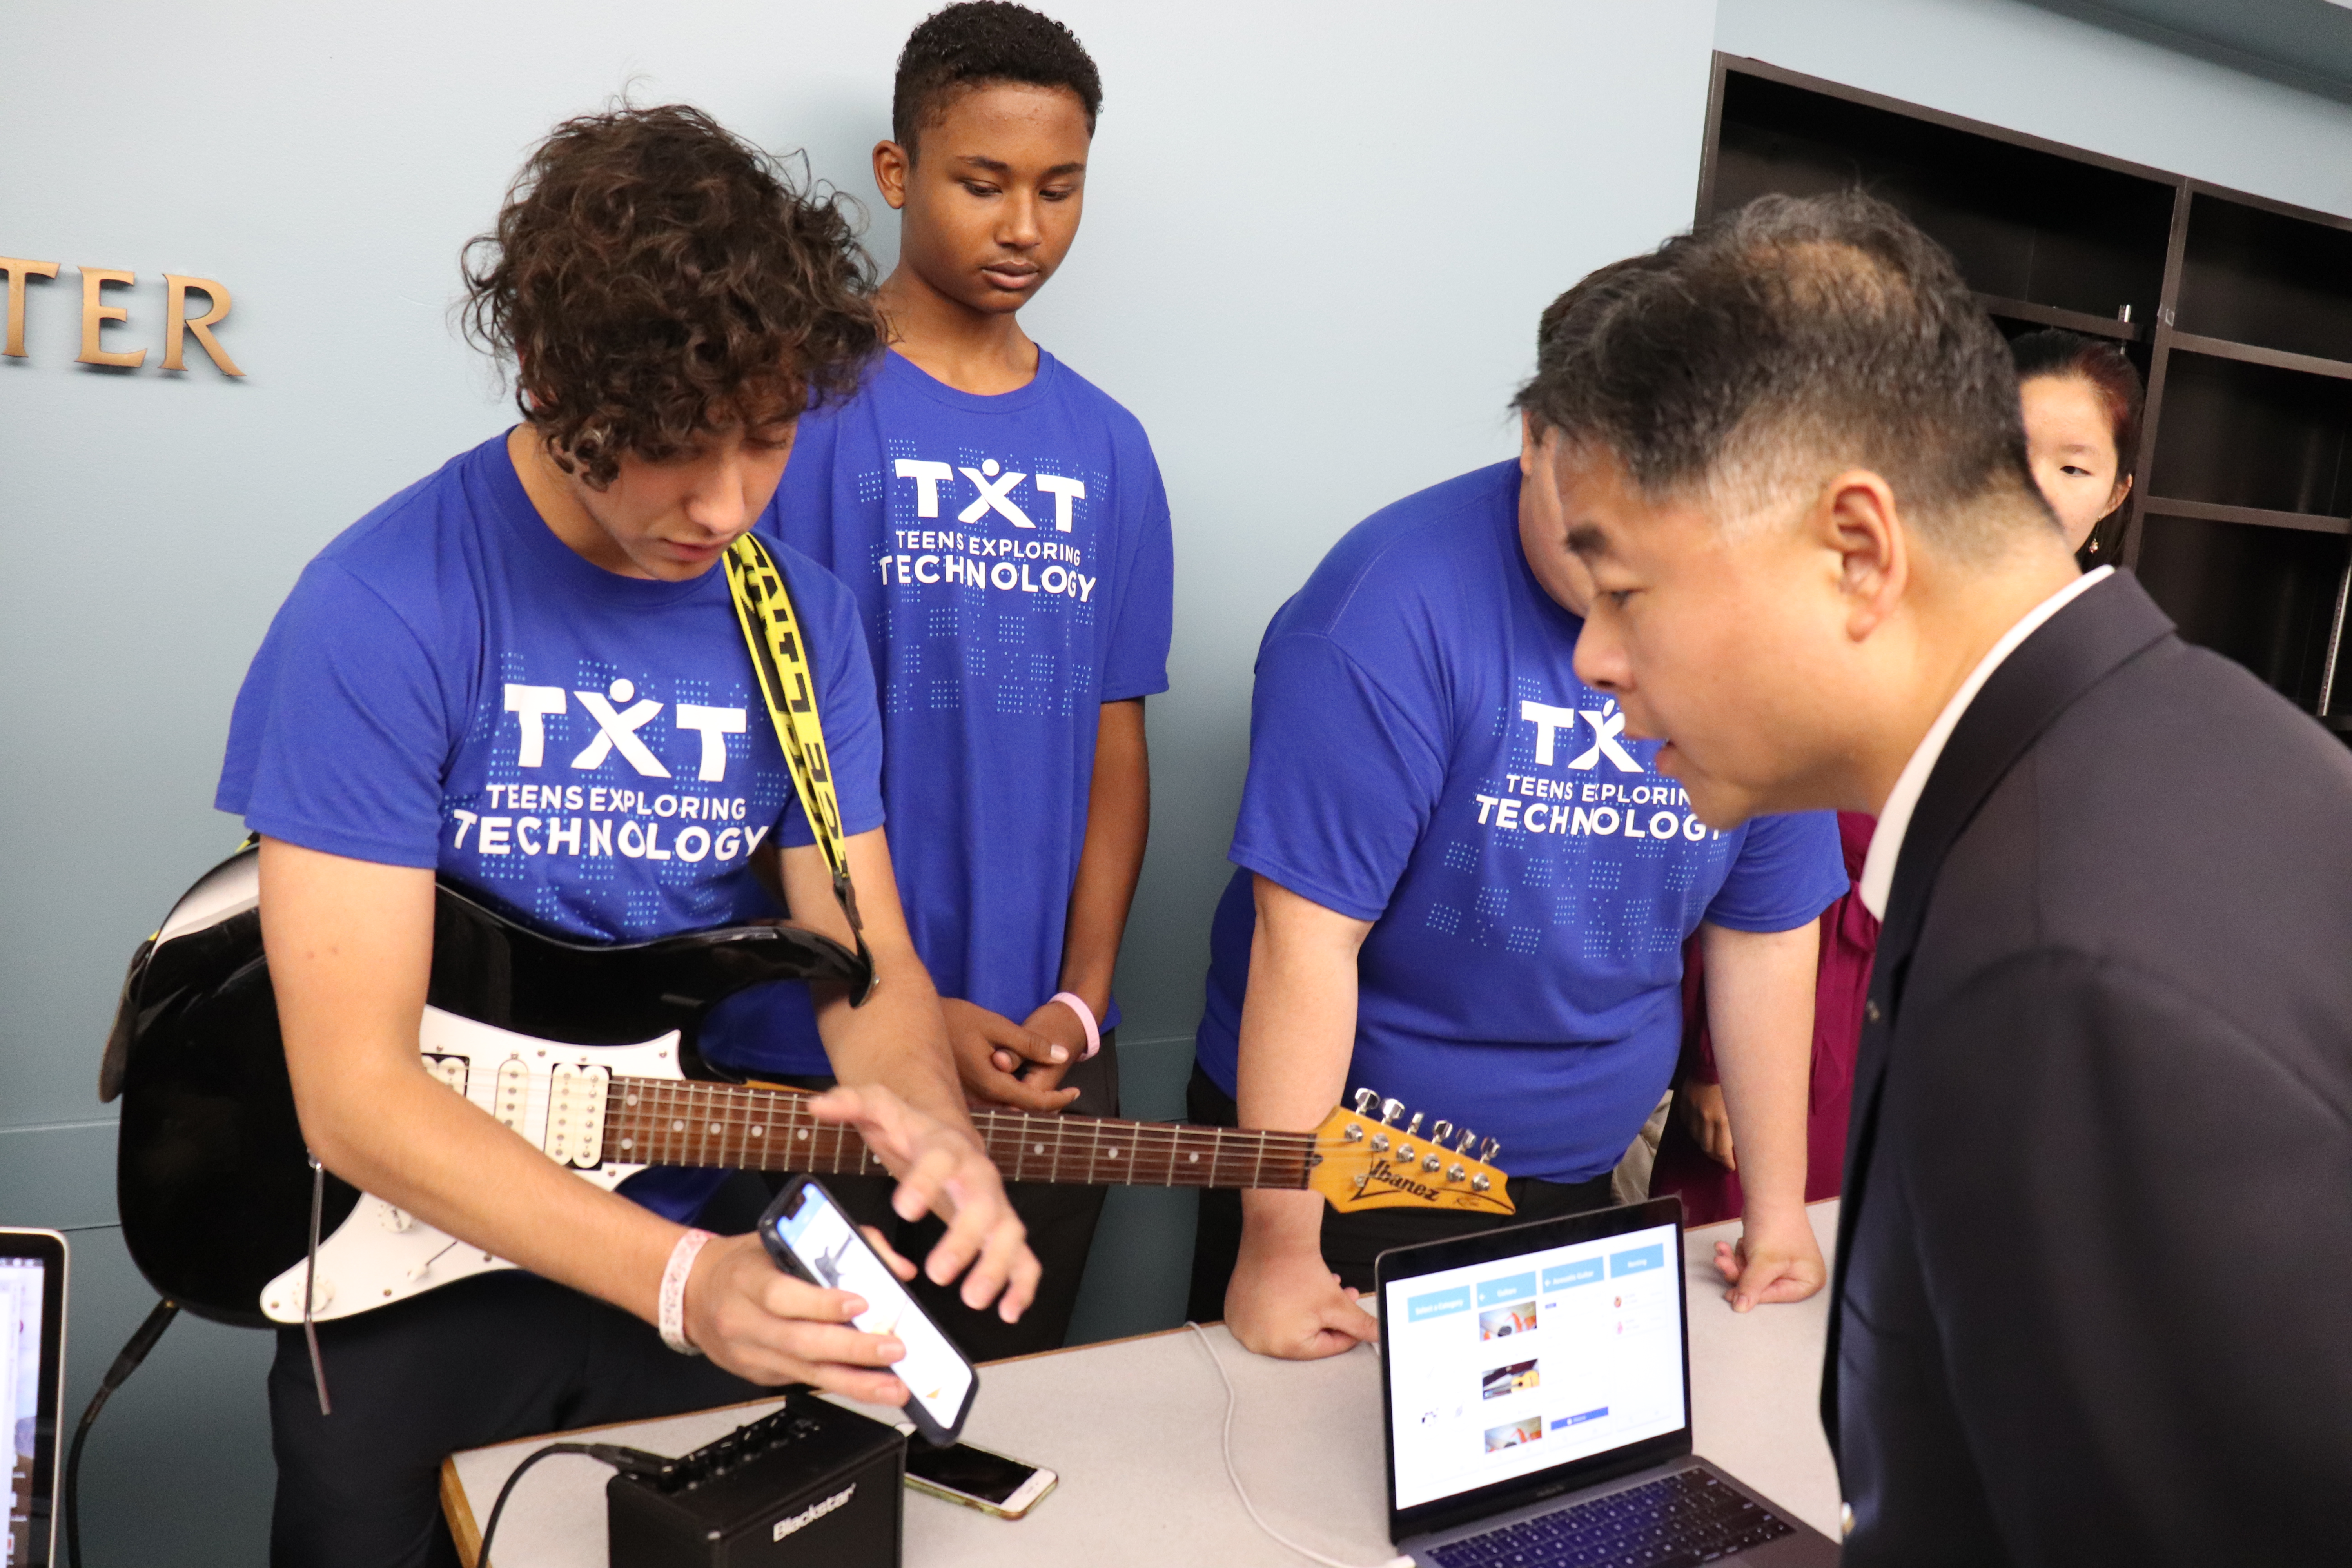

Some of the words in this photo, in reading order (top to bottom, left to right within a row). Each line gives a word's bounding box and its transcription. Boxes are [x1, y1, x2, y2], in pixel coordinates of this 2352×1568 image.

[895, 459, 1085, 533] TXT
[896, 531, 964, 550] TEENS
[969, 537, 1080, 566] EXPLORING
[880, 554, 1096, 602] TECHNOLOGY
[504, 679, 746, 782] TXT
[1521, 699, 1644, 772] TX
[486, 784, 584, 810] TEENS
[590, 788, 746, 820] EXPLORING
[1506, 775, 1573, 800] TEENS
[454, 809, 769, 862] TECHNOLOGY
[1369, 1160, 1440, 1201] Ibanez
[773, 1482, 856, 1542] Blackstar
